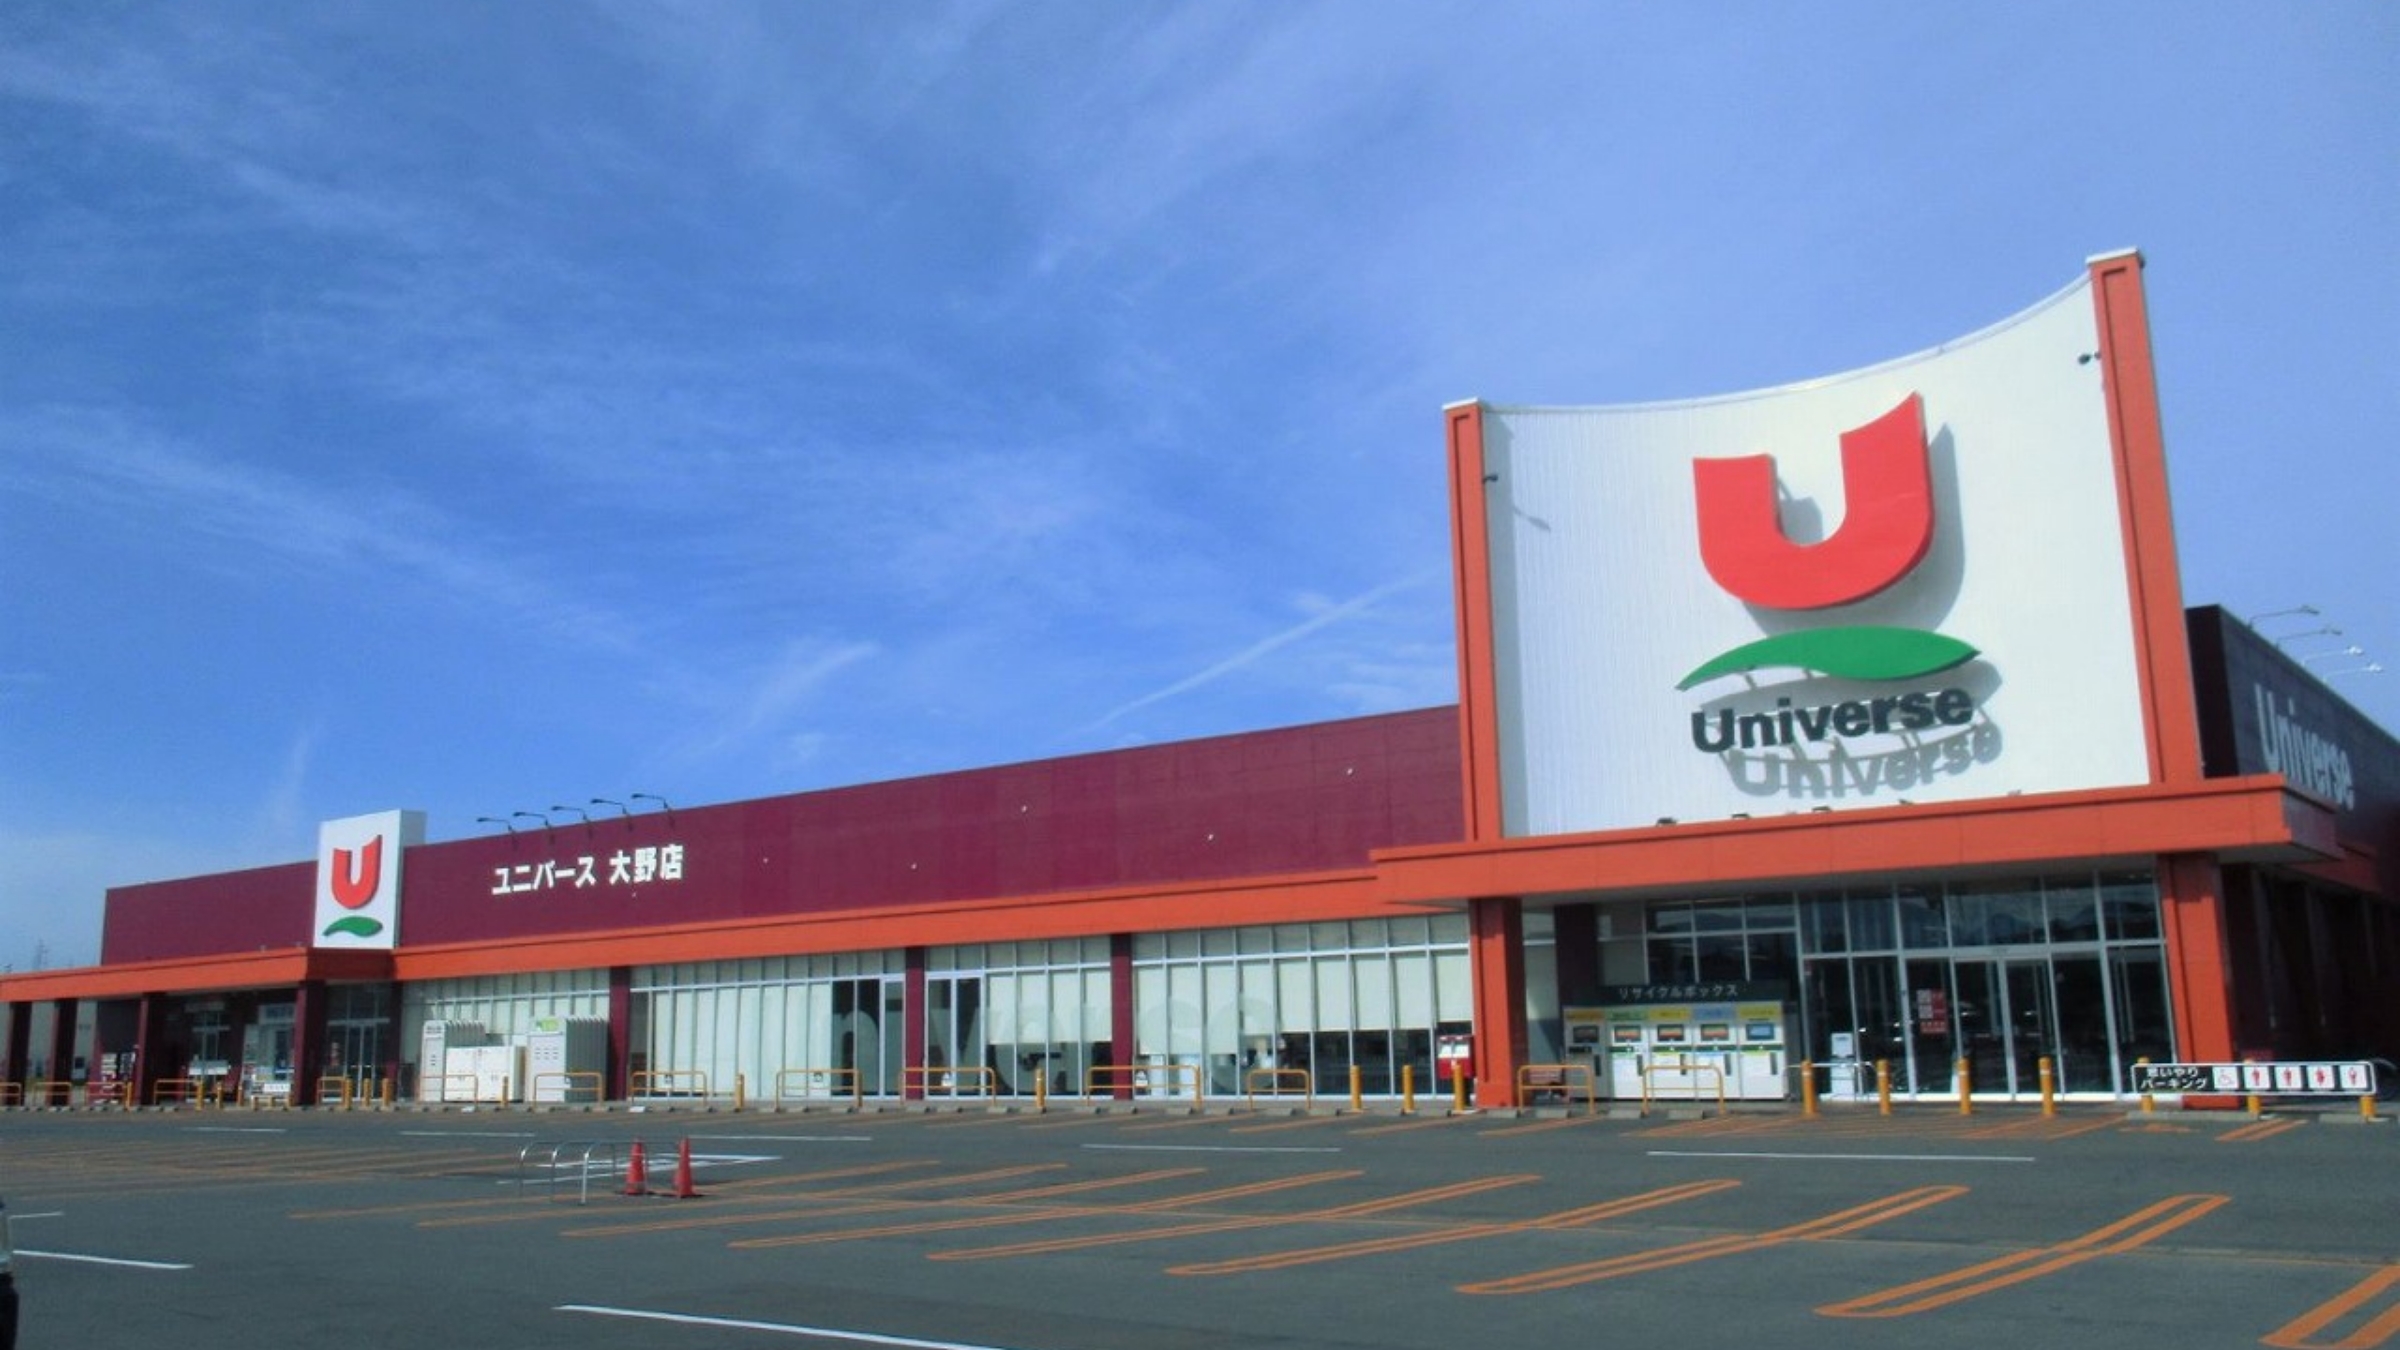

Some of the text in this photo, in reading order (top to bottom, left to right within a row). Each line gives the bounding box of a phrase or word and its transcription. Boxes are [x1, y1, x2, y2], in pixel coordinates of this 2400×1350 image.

[1693, 391, 1936, 612] U
[1691, 687, 1975, 753] Universe
[2254, 683, 2355, 811] Universe
[331, 834, 383, 910] U
[491, 843, 684, 895] ユニバース 大野店
